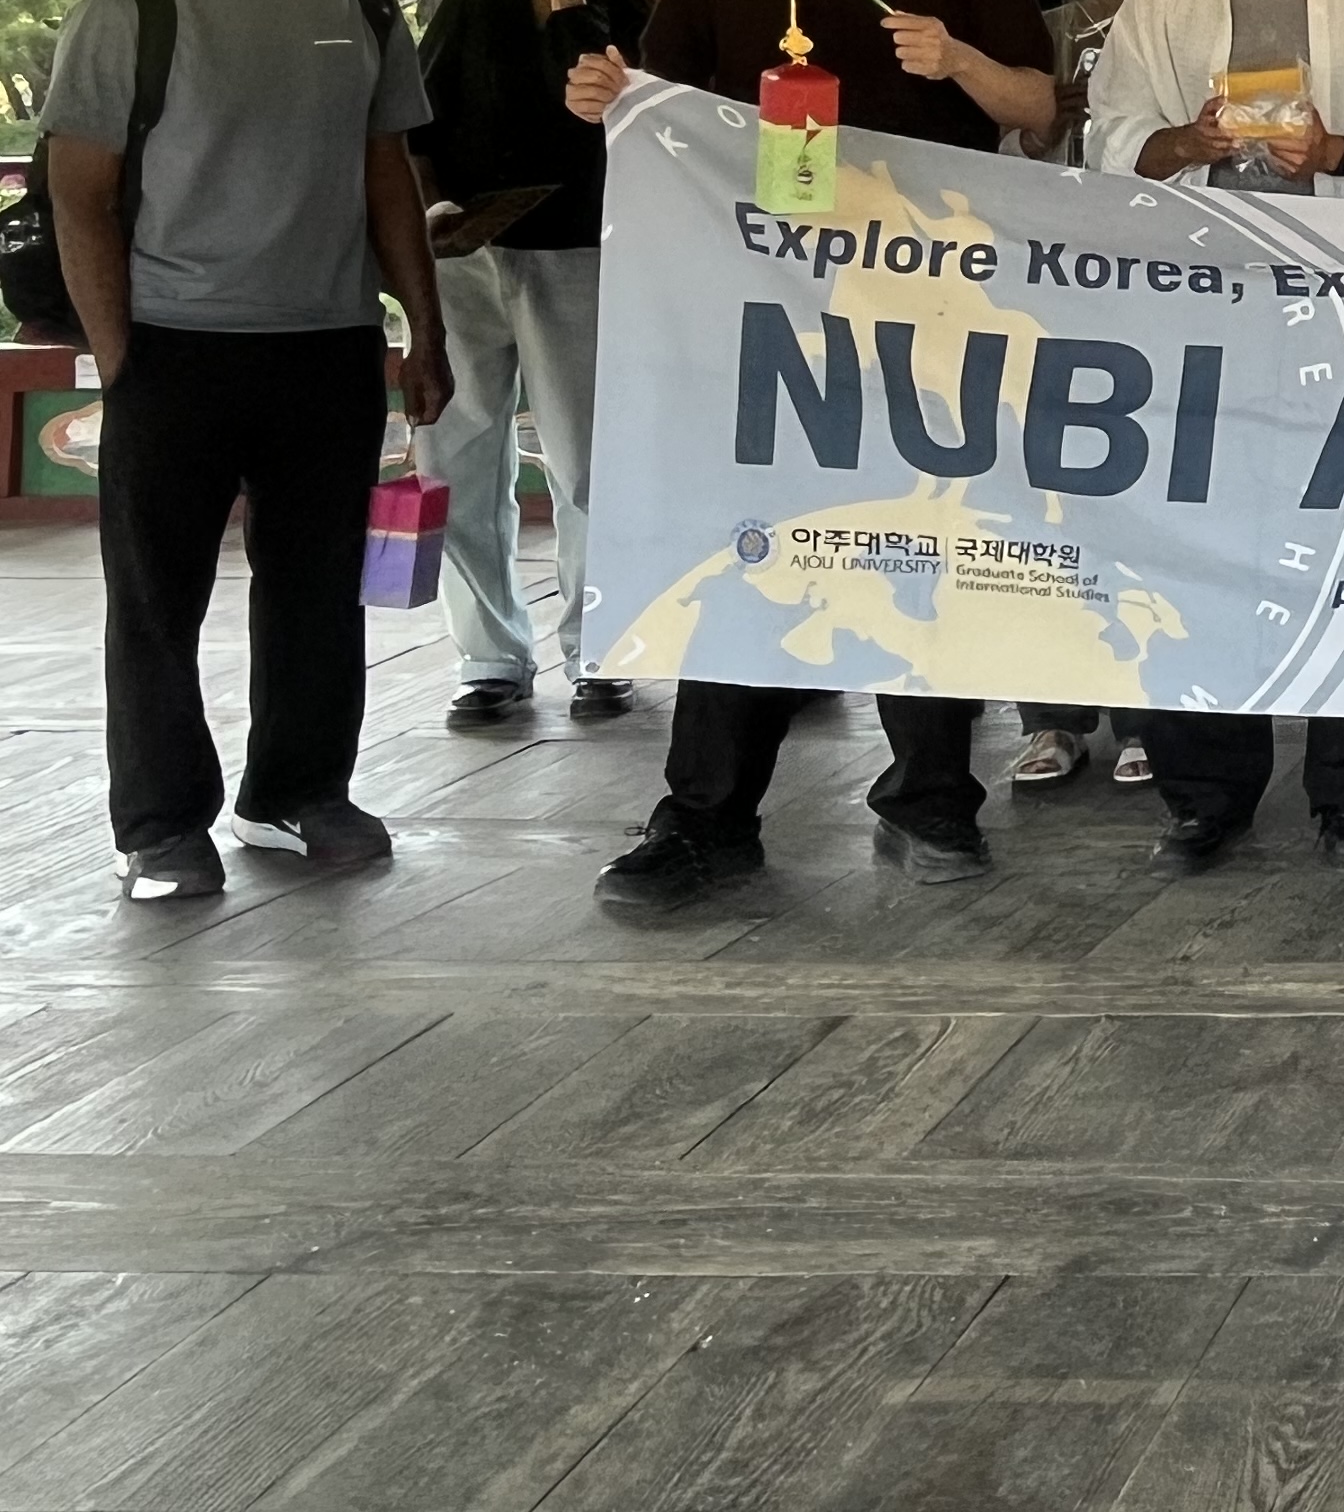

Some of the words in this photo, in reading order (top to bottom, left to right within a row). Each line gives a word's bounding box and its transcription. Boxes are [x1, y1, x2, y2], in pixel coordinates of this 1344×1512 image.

[735, 201, 998, 282] Explore
[1027, 239, 1245, 304] Korea,
[734, 301, 1224, 504] NUBI
[790, 554, 834, 571] AJOU
[842, 556, 941, 575] UNIVERSITY
[791, 528, 941, 557] 아주대학교
[955, 537, 1081, 570] 국제대학원
[956, 564, 1025, 581] Graduate
[1029, 569, 1080, 587] School
[1083, 574, 1099, 587] of
[1056, 585, 1111, 604] Studies
